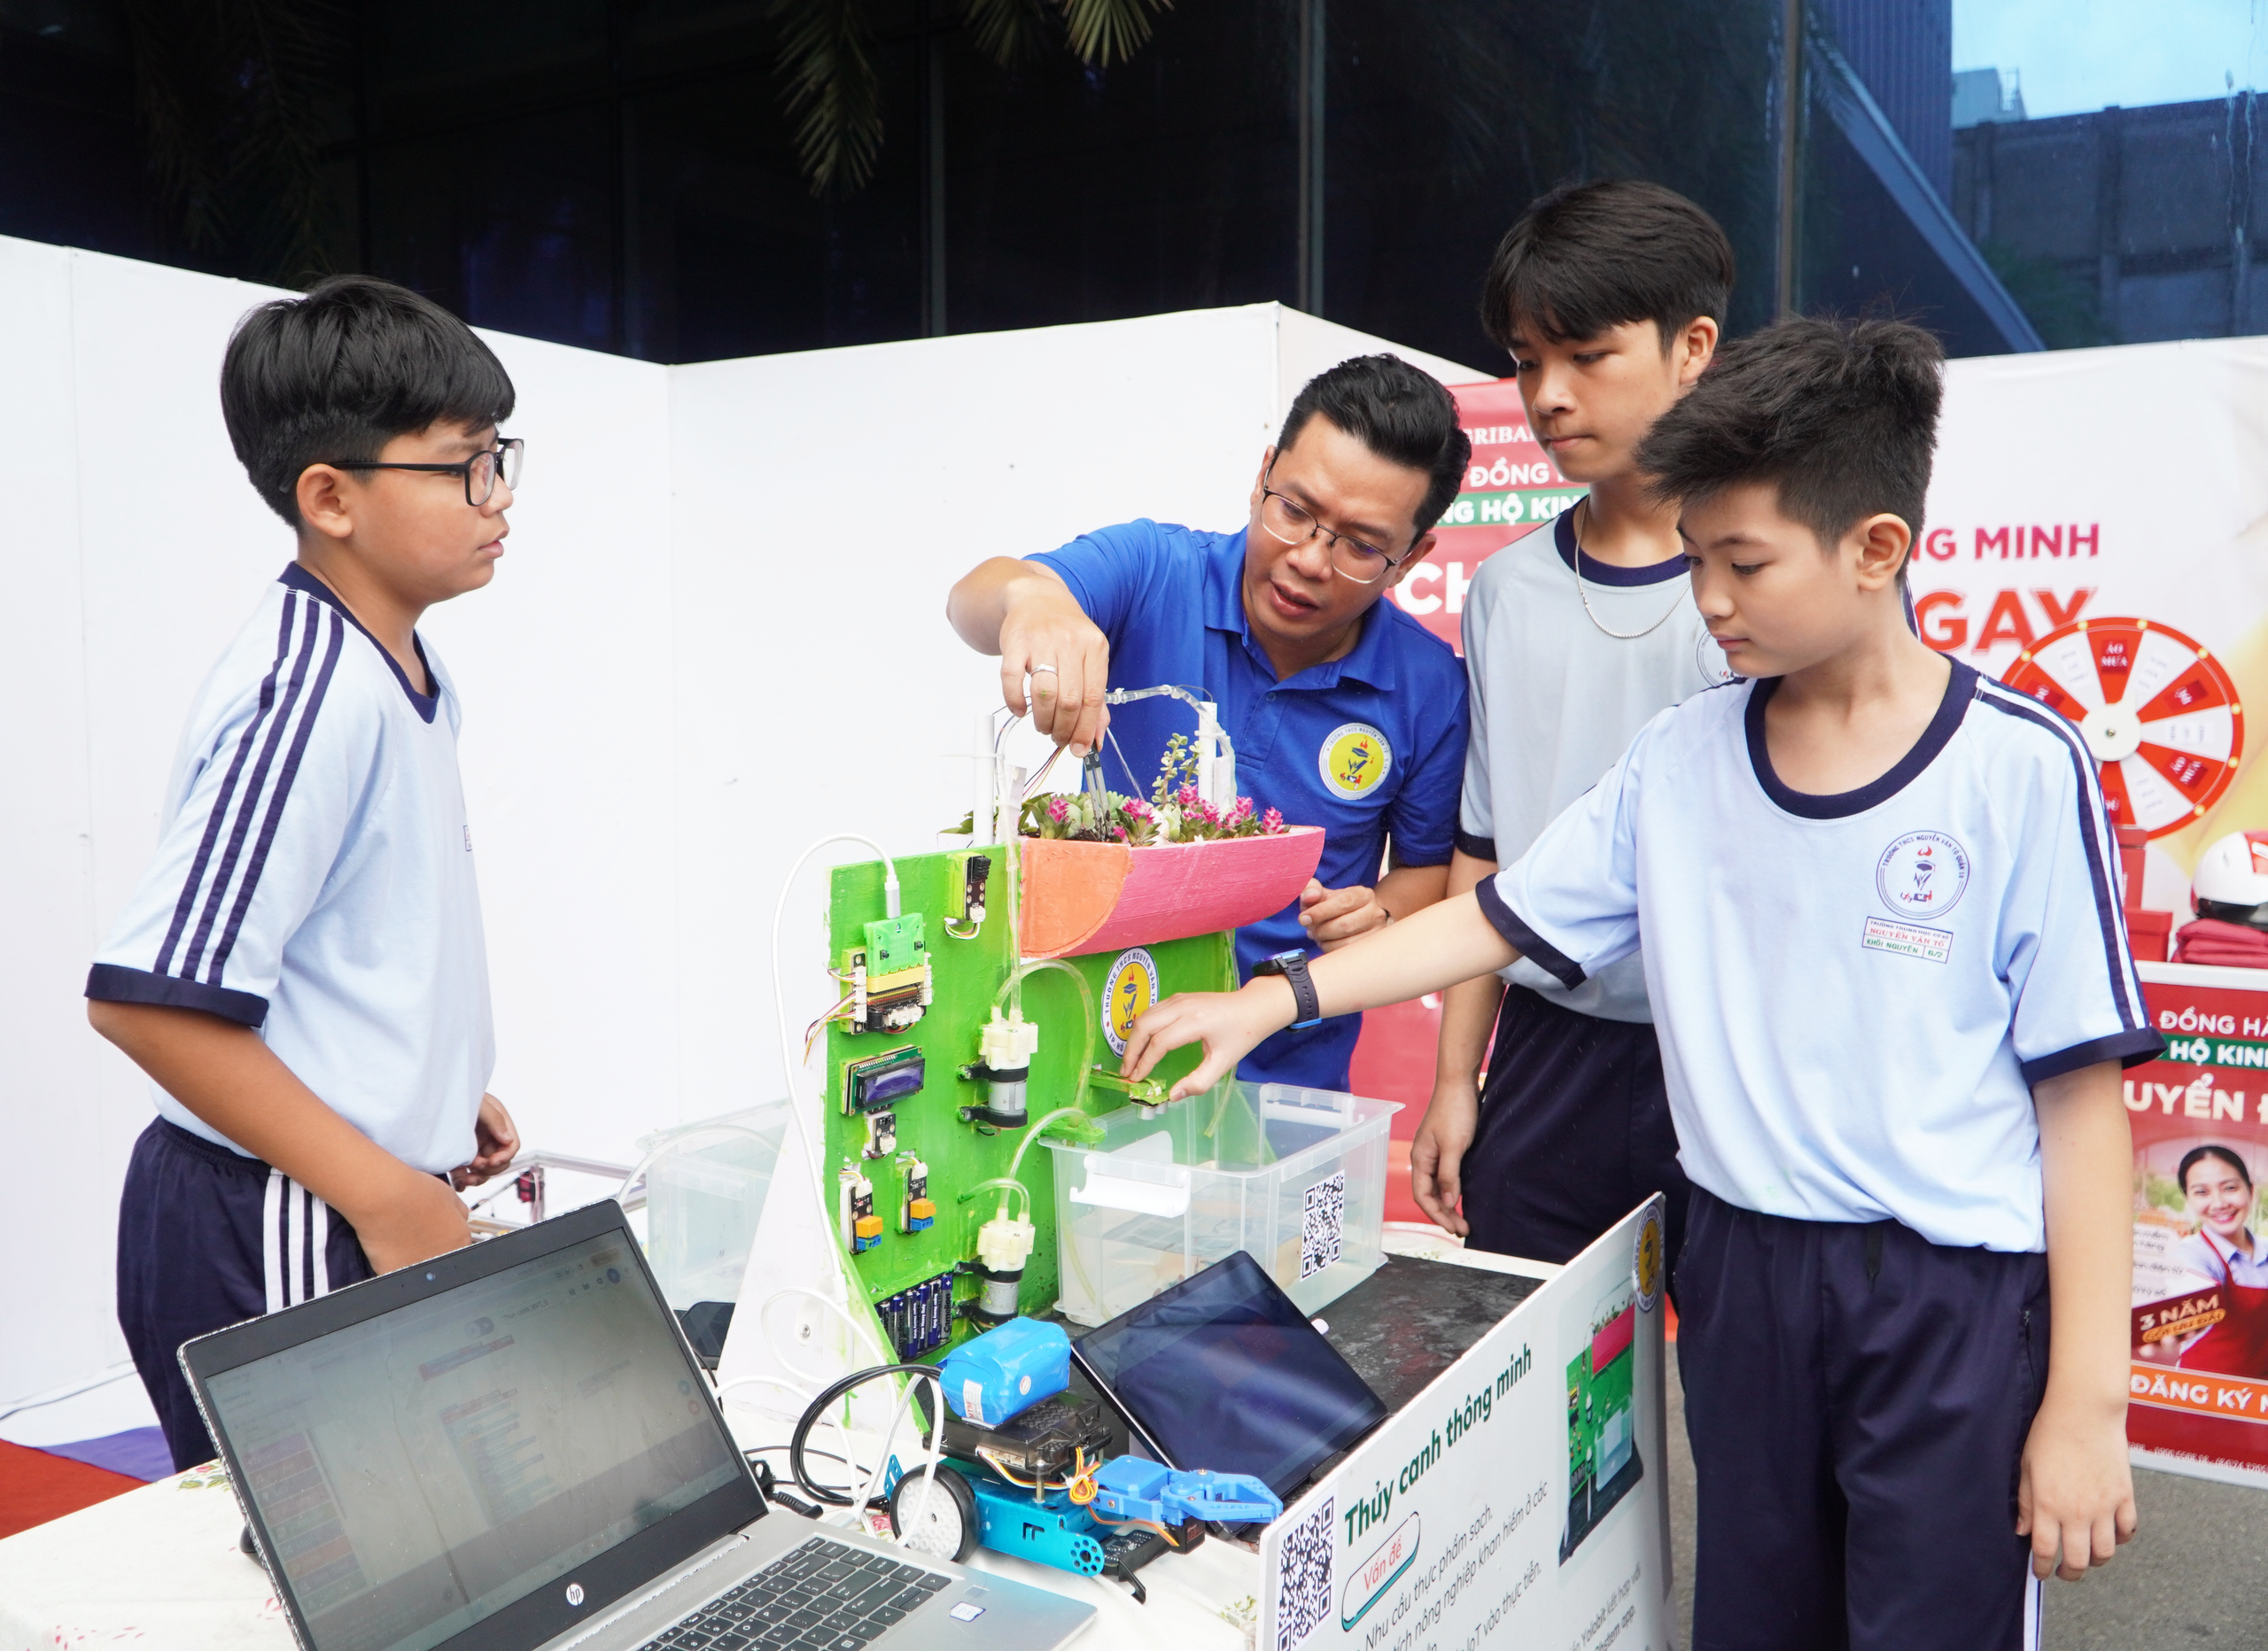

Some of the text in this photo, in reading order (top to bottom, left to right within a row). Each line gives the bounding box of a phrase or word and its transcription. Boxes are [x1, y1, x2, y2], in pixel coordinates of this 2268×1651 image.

[1480, 492, 1524, 526] HỘ
[1975, 523, 2099, 560] MINH
[2159, 1005, 2235, 1035] ĐỒNG
[2170, 1037, 2211, 1066] HỘ
[2140, 1294, 2219, 1330] 3 NĂM
[2130, 1373, 2210, 1405] ĐĂNG
[2217, 1387, 2254, 1411] KÝ
[1345, 1343, 1532, 1547] Thủy canh thông minh
[1363, 1534, 1402, 1592] Vấn đề
[1365, 1504, 1493, 1651] Nhu cầu thực phẩm sạch.
[1415, 1599, 1441, 1641] nông
[1443, 1561, 1477, 1608] nghiệp
[1478, 1533, 1501, 1569] khan
[1503, 1507, 1524, 1542] hiếm
[1534, 1481, 1548, 1508] các
[567, 1584, 584, 1605] hp
[1483, 1608, 1501, 1637] vào
[1502, 1582, 1522, 1615] thực
